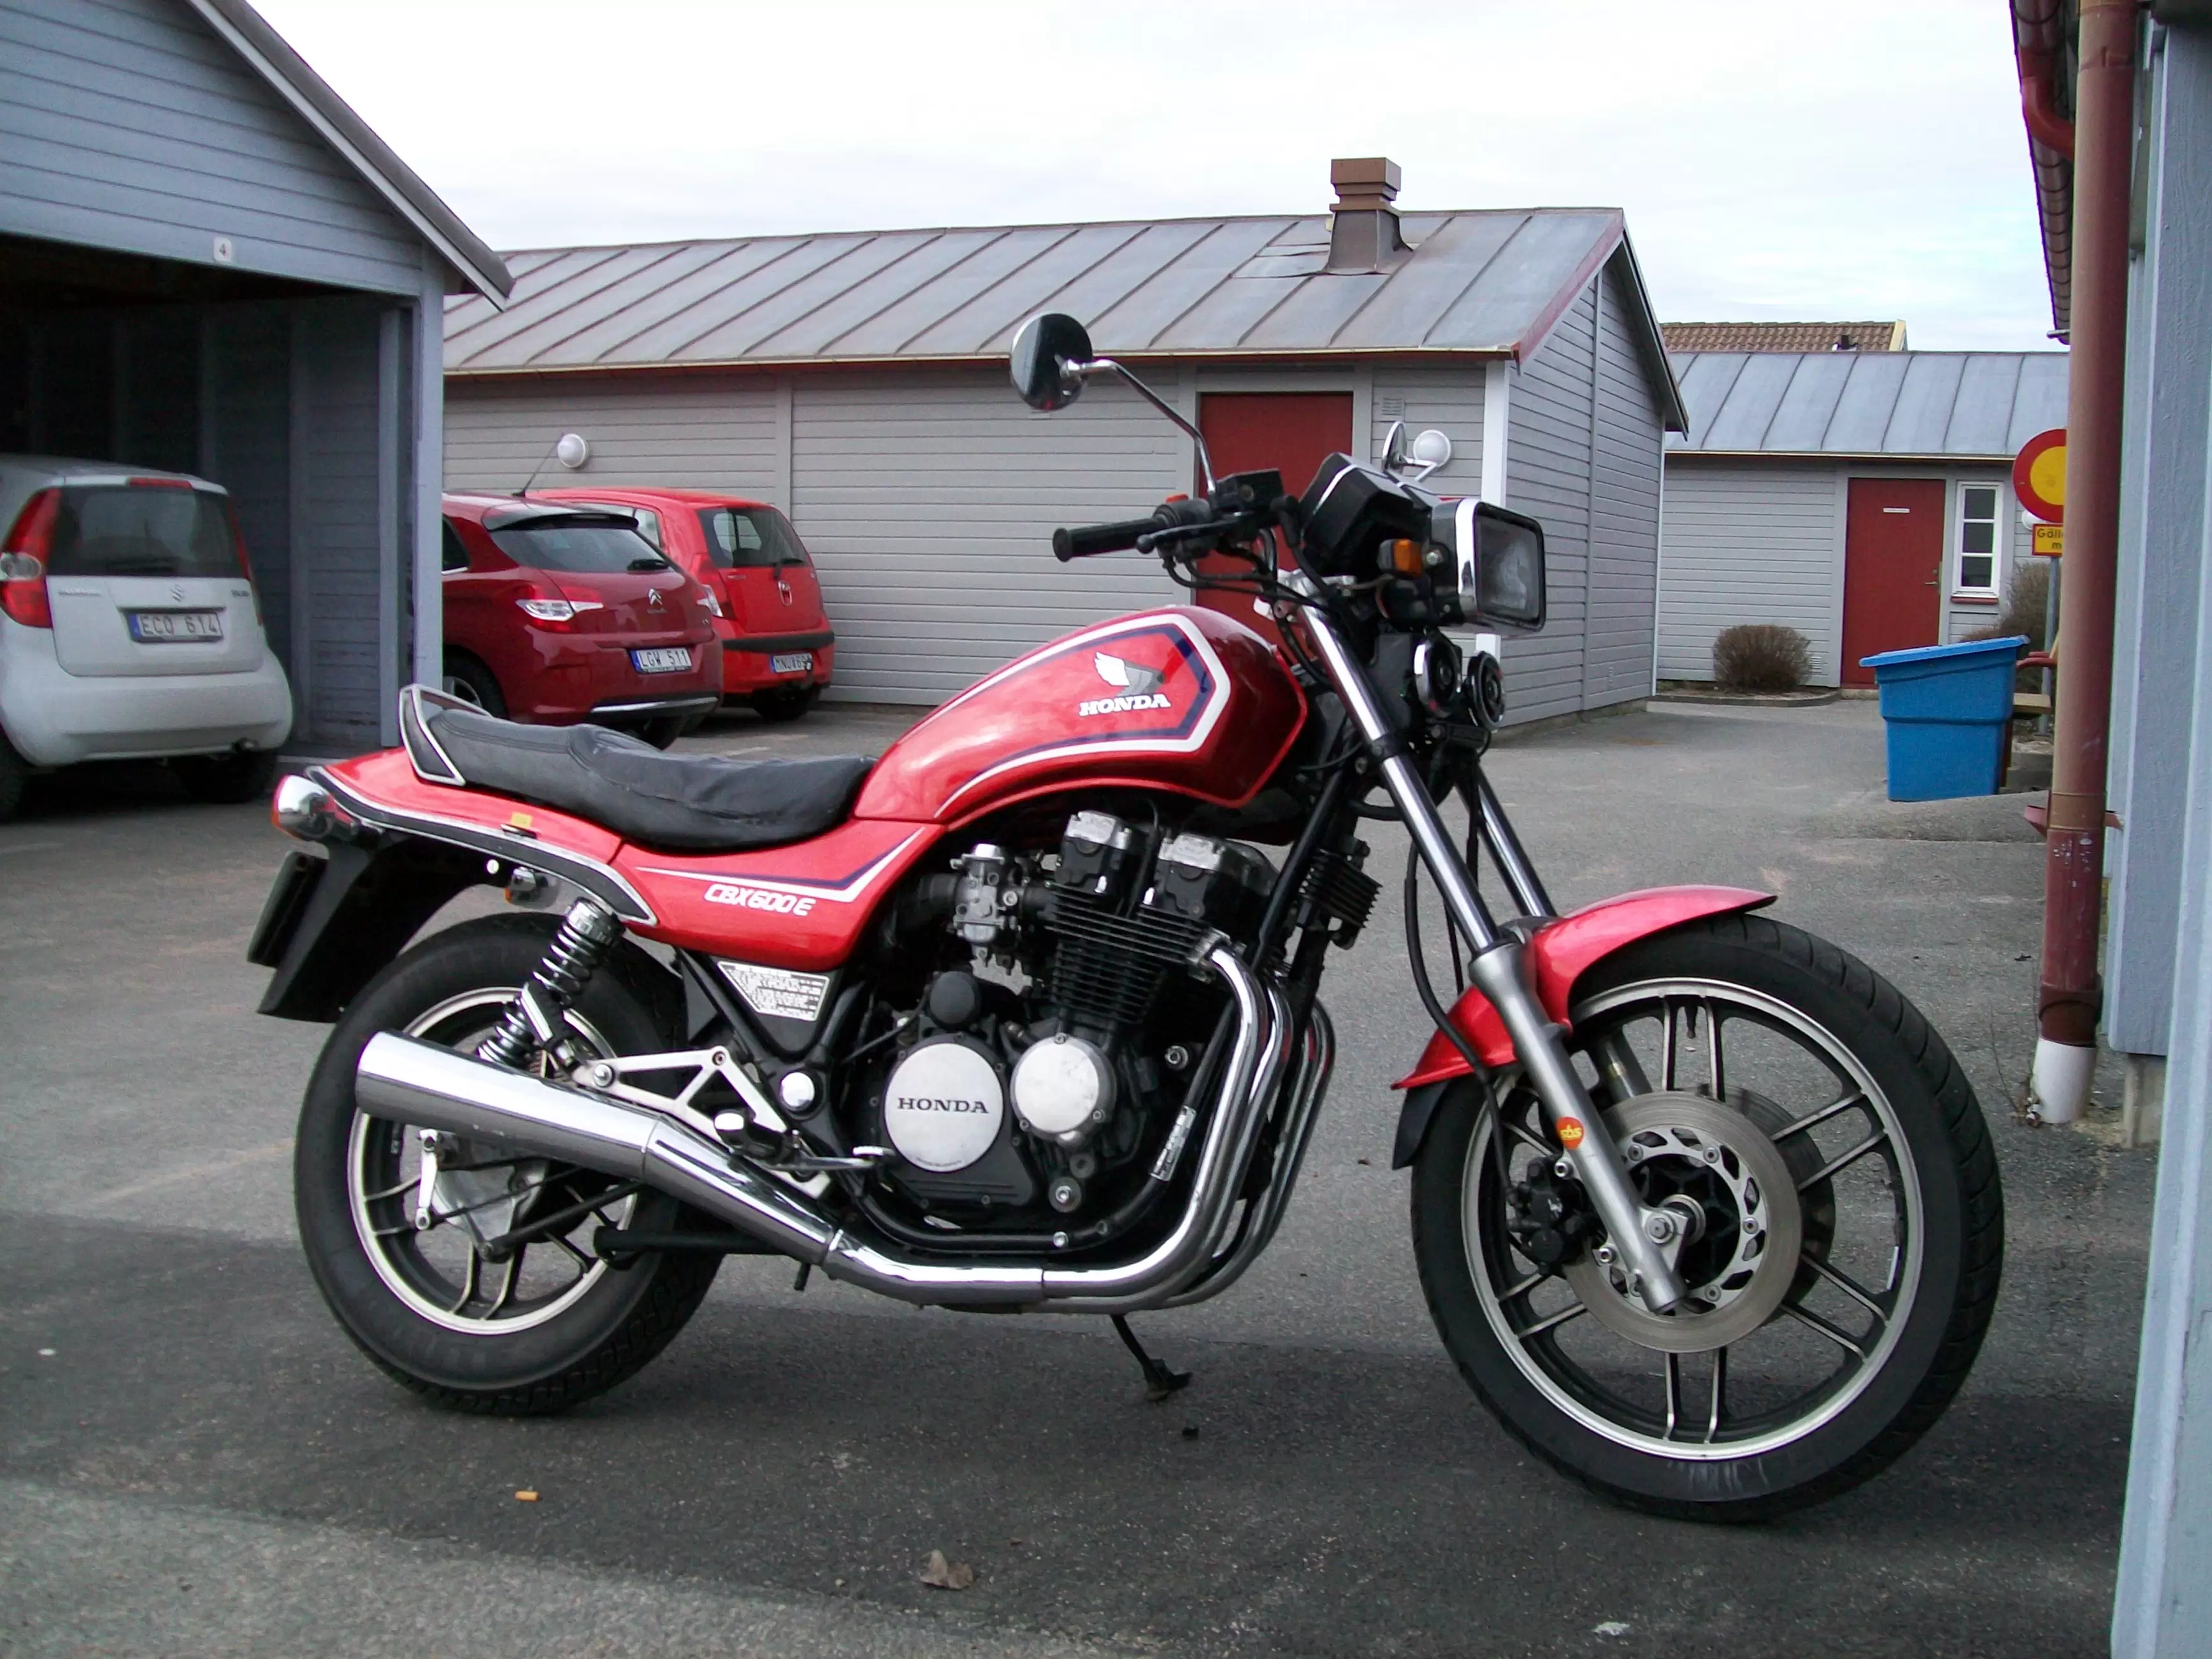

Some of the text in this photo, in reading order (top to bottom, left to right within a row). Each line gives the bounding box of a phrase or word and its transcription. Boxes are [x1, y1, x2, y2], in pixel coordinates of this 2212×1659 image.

[219, 243, 227, 257] 4
[2037, 528, 2062, 538] Gäll
[184, 614, 217, 634] 614
[666, 649, 689, 666] 511
[1079, 693, 1172, 717] HONDA
[703, 883, 817, 917] CBX600E
[897, 1096, 989, 1114] HONDA
